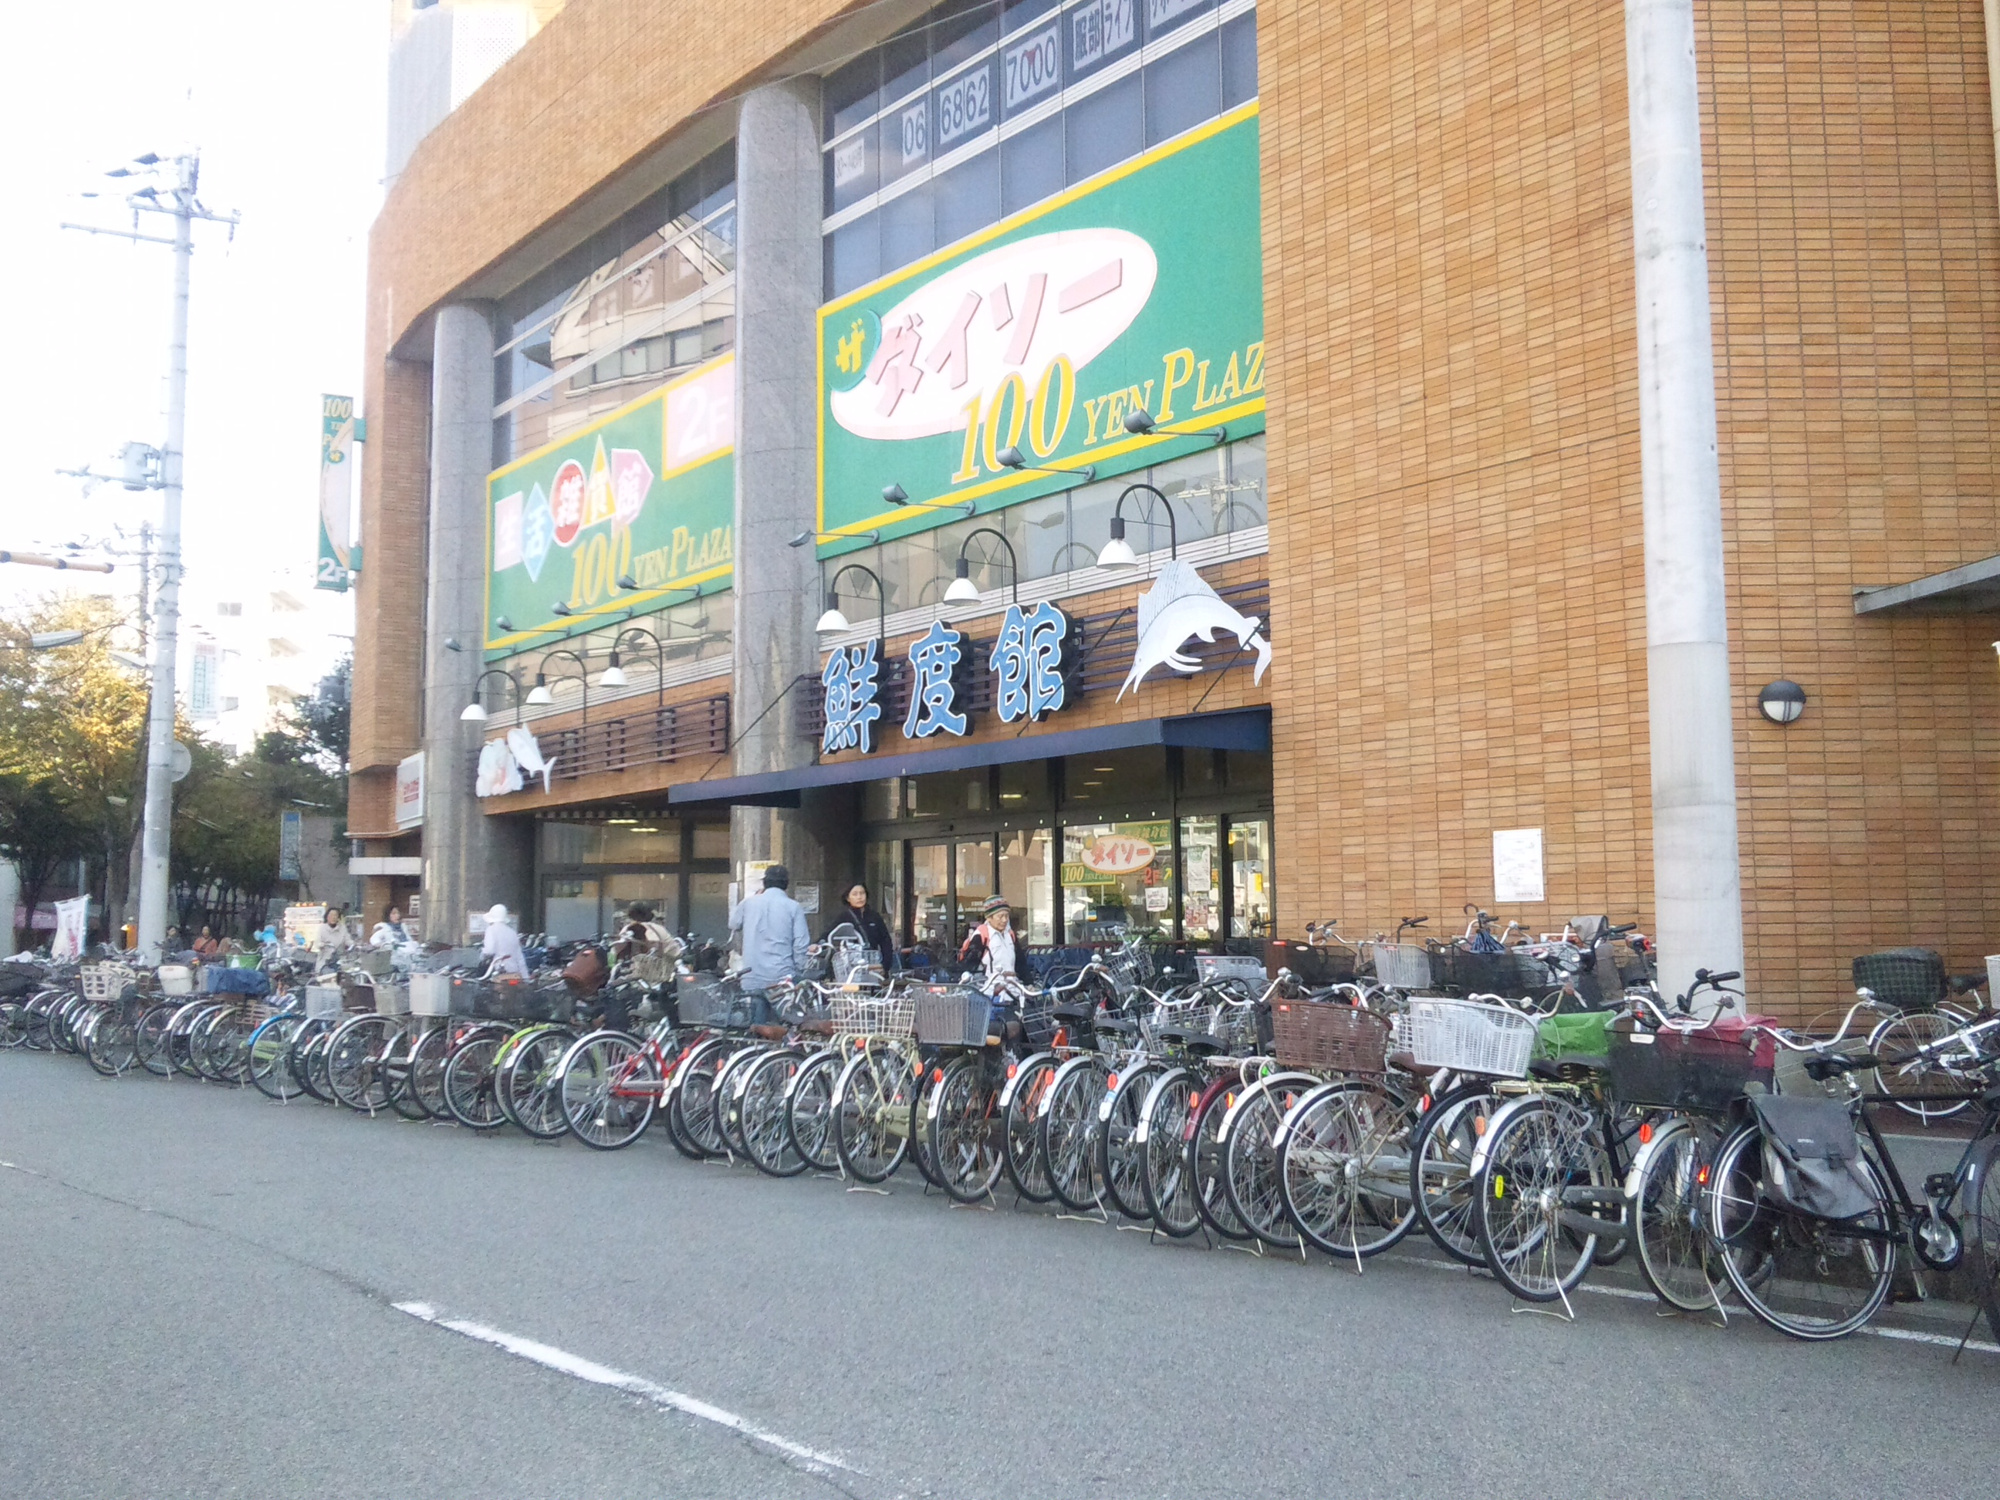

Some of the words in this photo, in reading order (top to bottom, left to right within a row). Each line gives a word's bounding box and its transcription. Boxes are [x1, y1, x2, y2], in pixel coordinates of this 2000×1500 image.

[904, 109, 925, 156] 06
[941, 73, 988, 136] 6862
[1007, 35, 1056, 100] 7000
[835, 318, 866, 374] ザ
[866, 258, 1123, 417] ダイソー
[323, 398, 352, 419] 100
[677, 385, 730, 458] 2F
[951, 353, 1076, 485] 100
[1083, 379, 1154, 446] YEN
[1155, 341, 1265, 424] PLAZ
[318, 557, 347, 583] 2F
[567, 524, 631, 609] 100
[634, 546, 669, 588] YEN
[668, 525, 733, 578] PLAZA
[822, 600, 1067, 755] 鮮度館
[1065, 866, 1084, 882] 100
[1091, 843, 1150, 867] ダイソー
